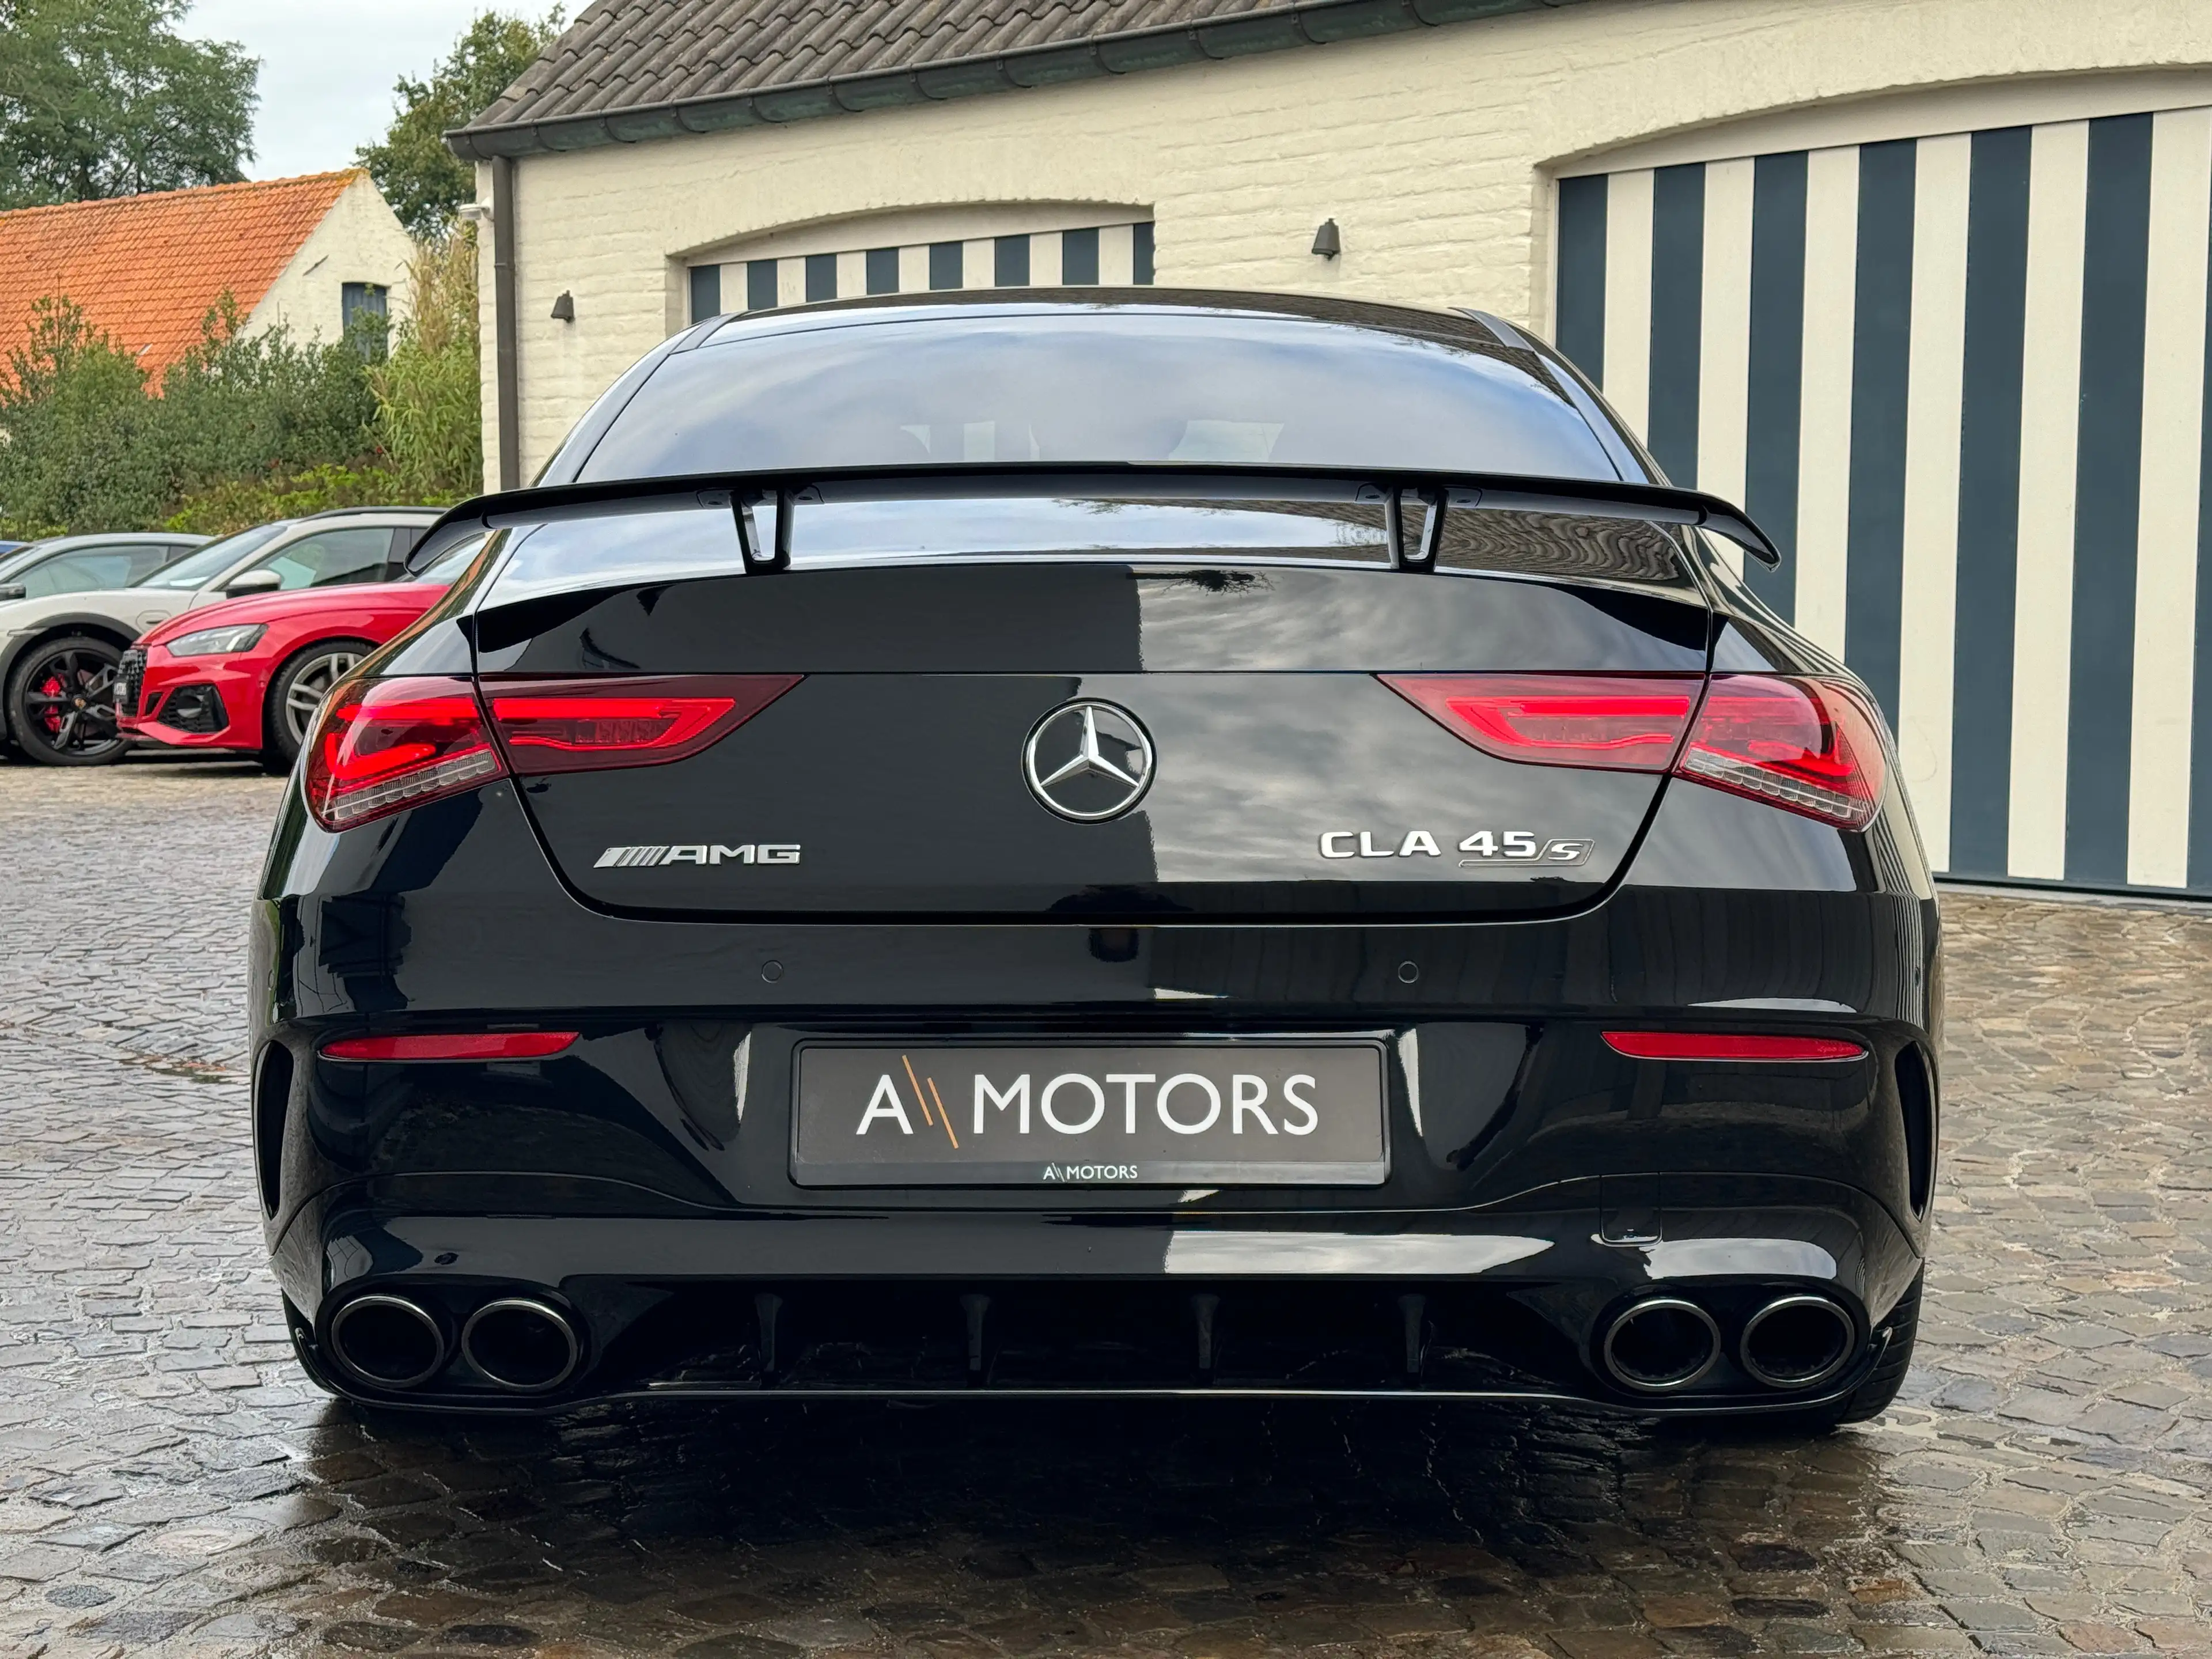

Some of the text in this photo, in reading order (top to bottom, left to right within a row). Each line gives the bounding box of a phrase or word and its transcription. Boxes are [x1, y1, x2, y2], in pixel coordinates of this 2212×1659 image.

[1320, 831, 1441, 858] CLA
[974, 1073, 1319, 1135] MOTORS
[1066, 1165, 1138, 1179] MOTORS
